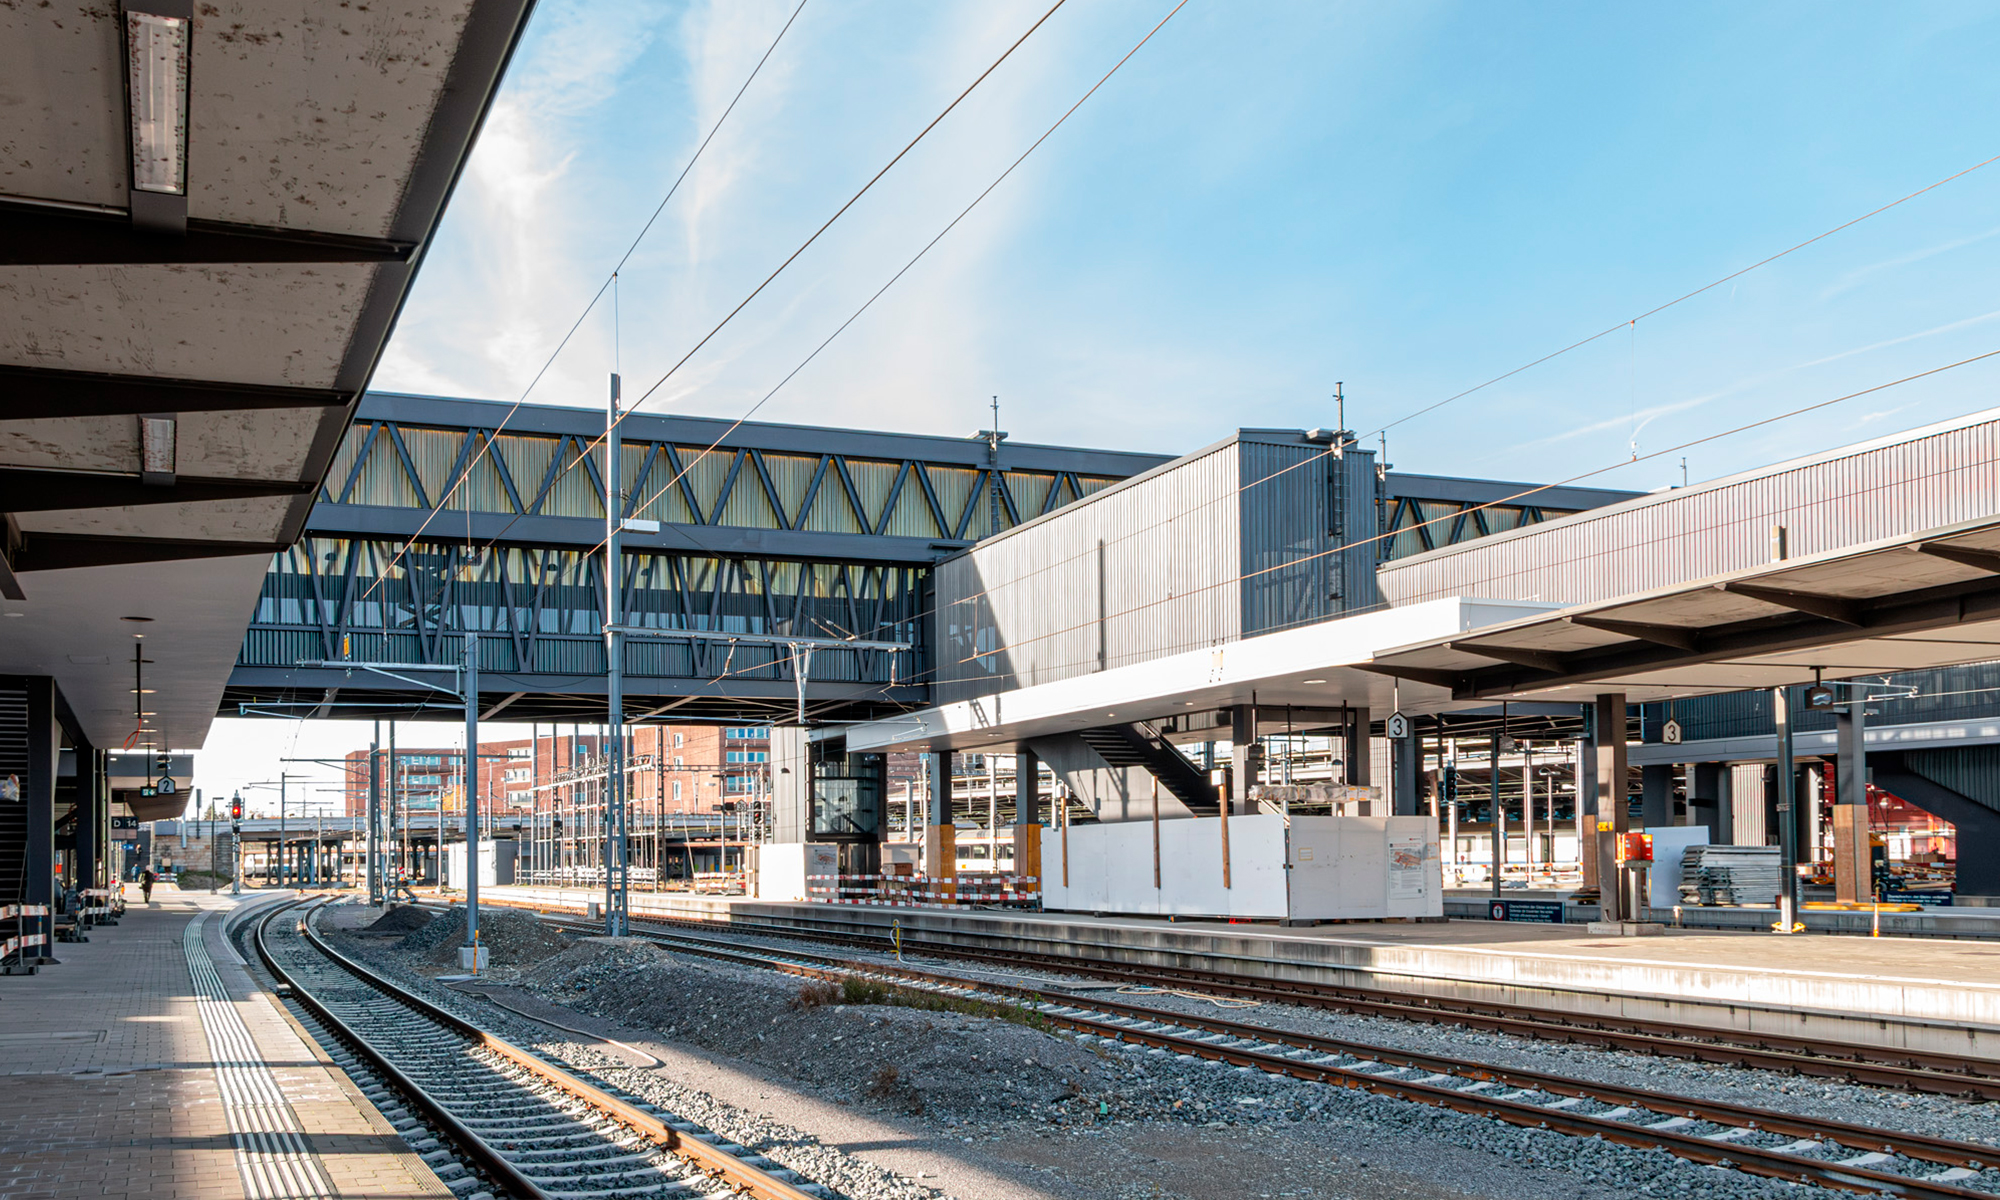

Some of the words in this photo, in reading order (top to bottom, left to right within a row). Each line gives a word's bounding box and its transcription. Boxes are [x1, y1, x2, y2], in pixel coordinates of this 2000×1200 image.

[1393, 718, 1402, 736] 3
[1667, 724, 1677, 742] 3
[163, 780, 170, 793] 2
[113, 820, 121, 828] D
[126, 820, 137, 828] 14
